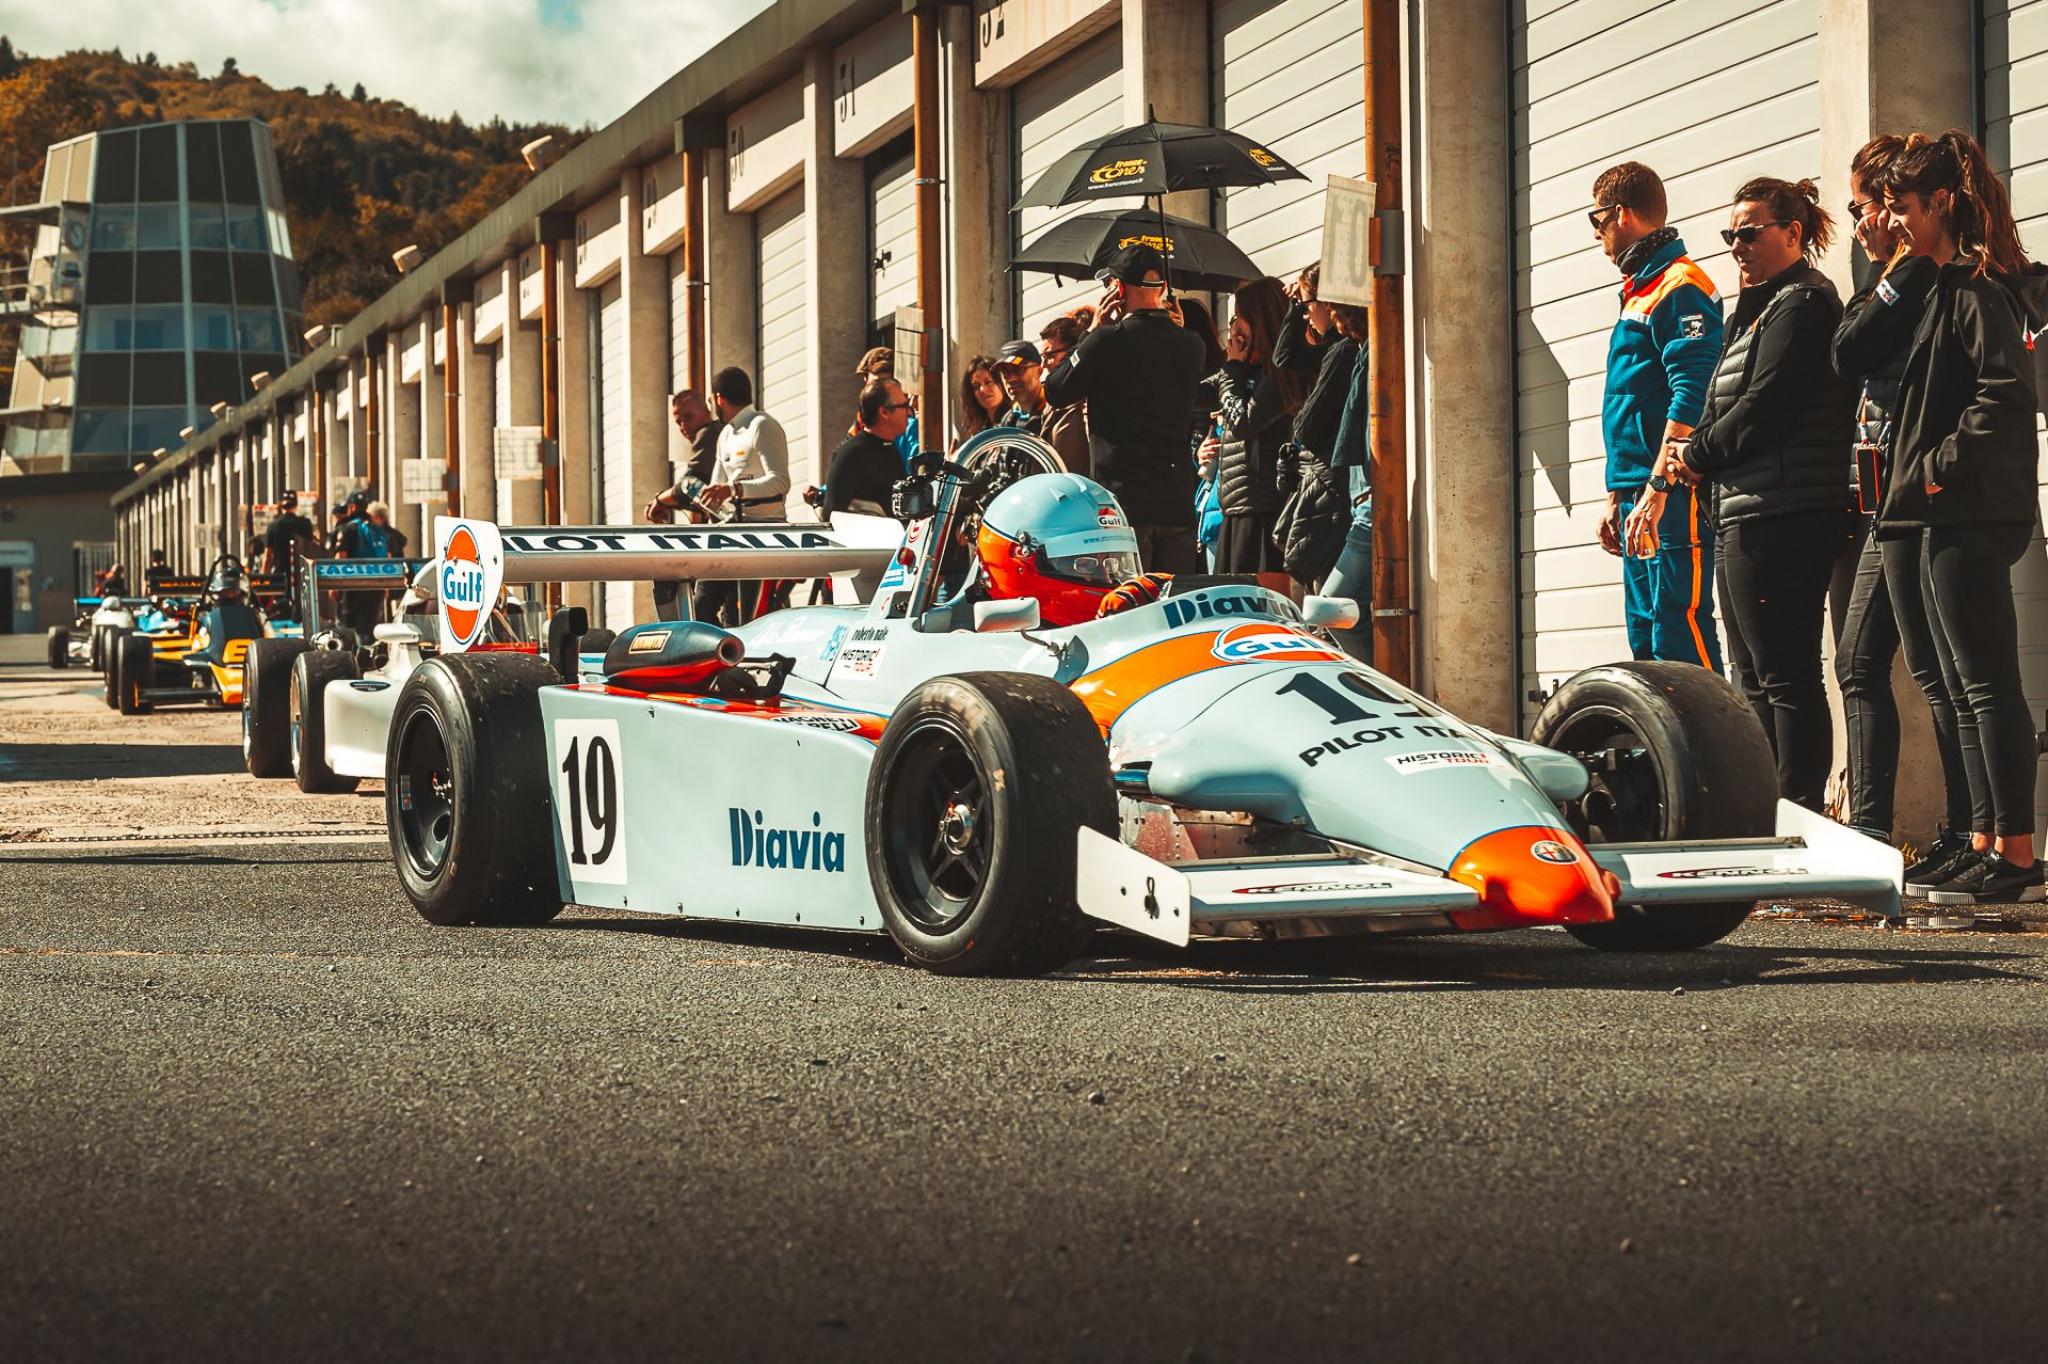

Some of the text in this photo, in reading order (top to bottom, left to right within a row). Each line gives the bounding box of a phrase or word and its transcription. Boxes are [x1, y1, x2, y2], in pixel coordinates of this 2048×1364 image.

[648, 534, 847, 550] ITALIA
[443, 566, 482, 603] Gulf
[1163, 593, 1299, 630] Diavia
[840, 649, 878, 661] HISTORIC
[1275, 672, 1435, 726] 19
[1299, 727, 1405, 768] PILOT
[1396, 752, 1482, 765] HISTORIC
[562, 735, 617, 865] 19
[728, 807, 846, 873] Diavia
